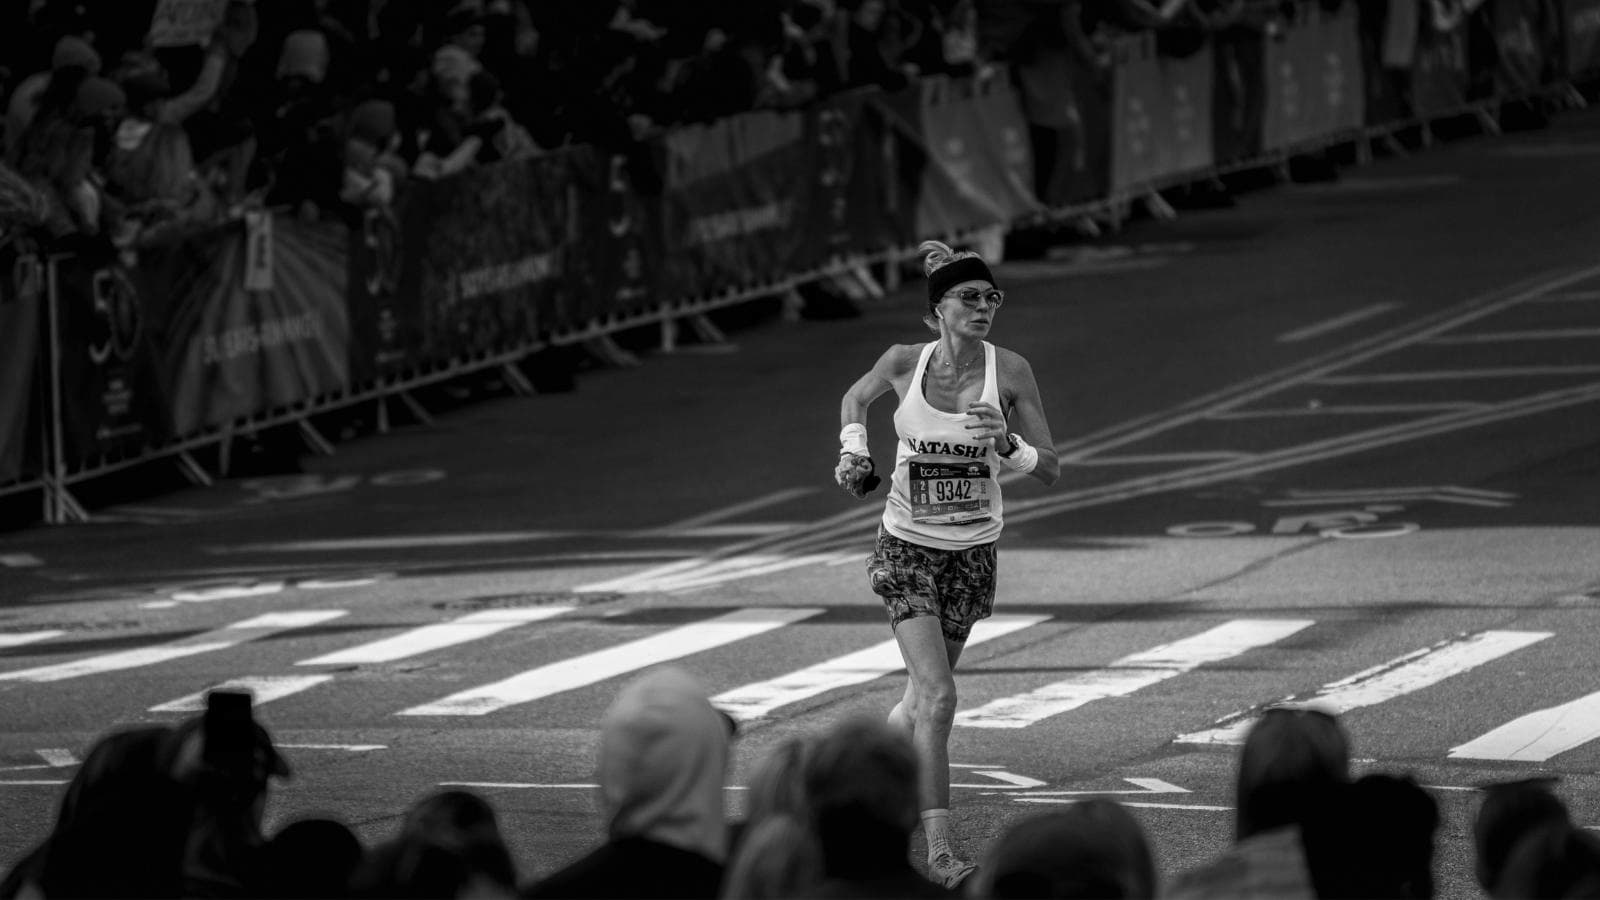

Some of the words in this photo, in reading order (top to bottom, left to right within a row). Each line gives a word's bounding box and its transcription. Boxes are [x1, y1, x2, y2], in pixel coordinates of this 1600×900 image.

[908, 438, 987, 458] NATASHA
[920, 467, 940, 477] tcs
[936, 480, 972, 502] 9342
